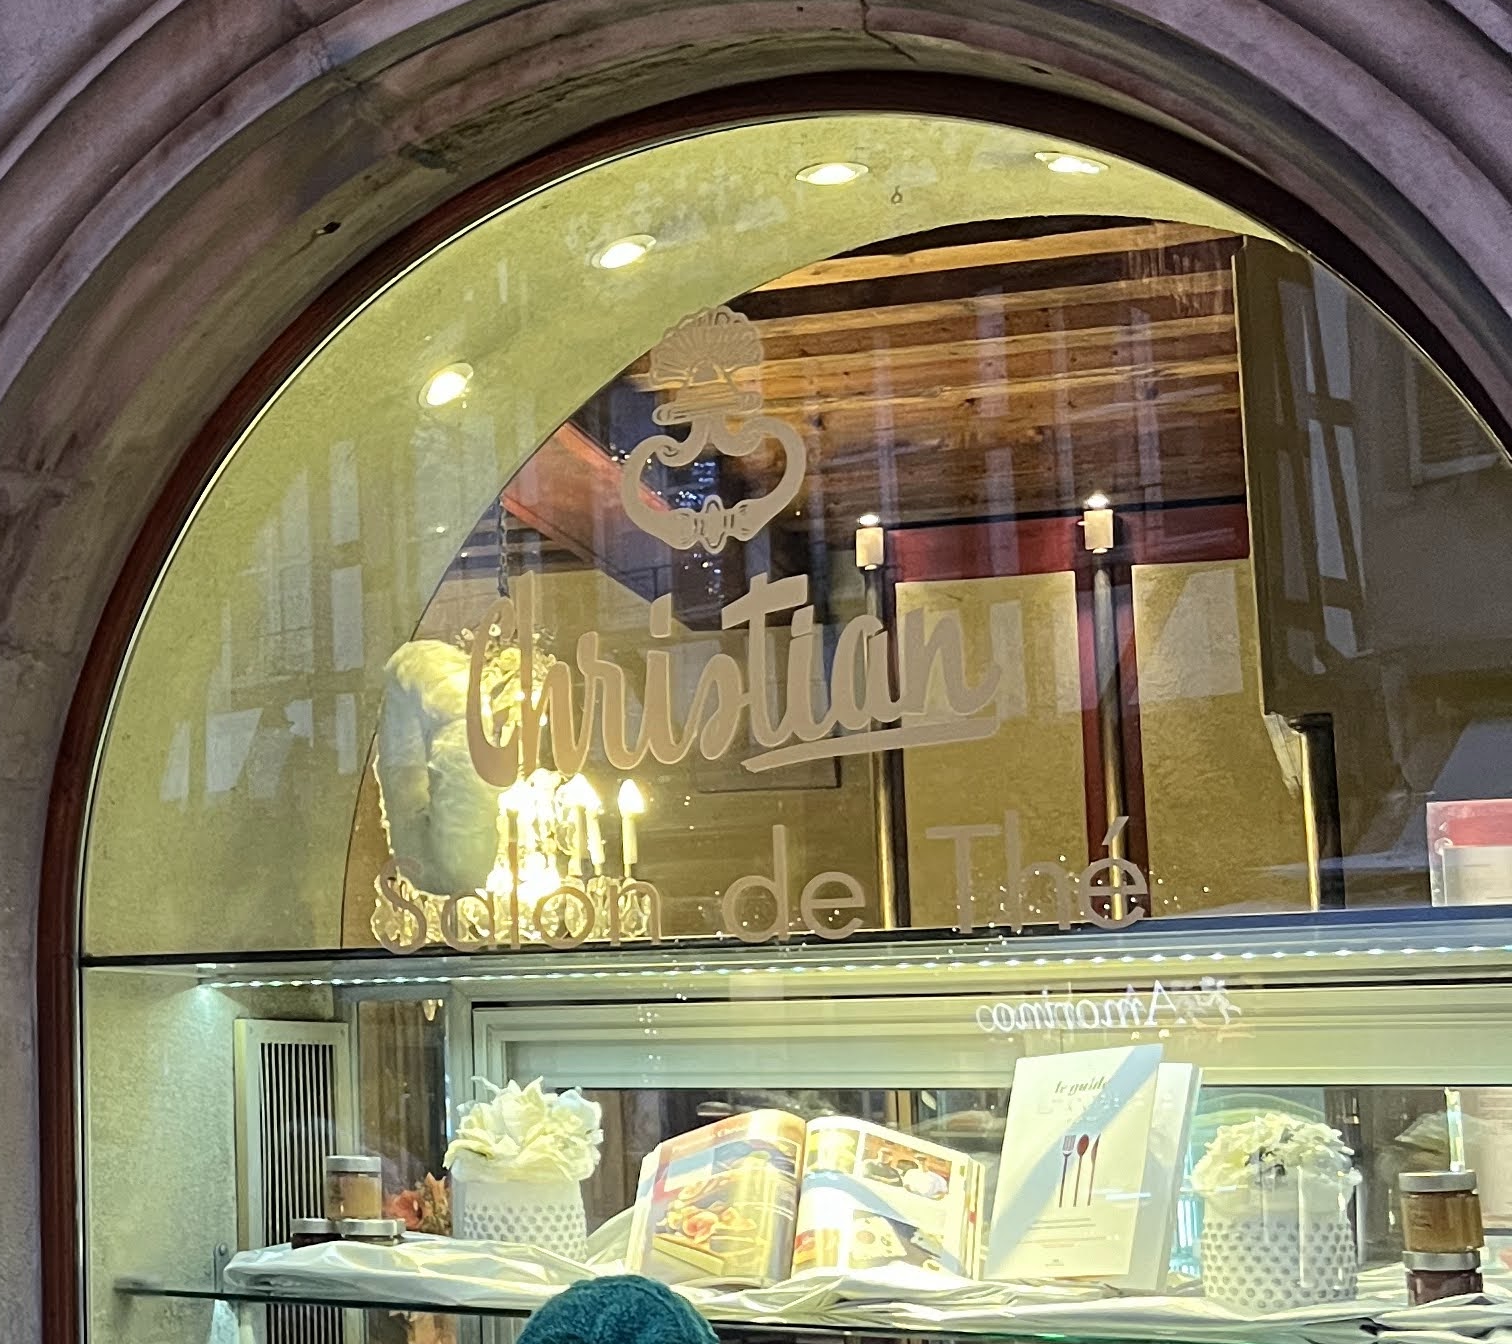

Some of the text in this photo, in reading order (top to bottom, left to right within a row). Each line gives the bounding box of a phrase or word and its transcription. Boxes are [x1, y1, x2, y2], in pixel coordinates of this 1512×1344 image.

[465, 569, 1003, 788] Christian
[378, 810, 1150, 955] Salon de Thé
